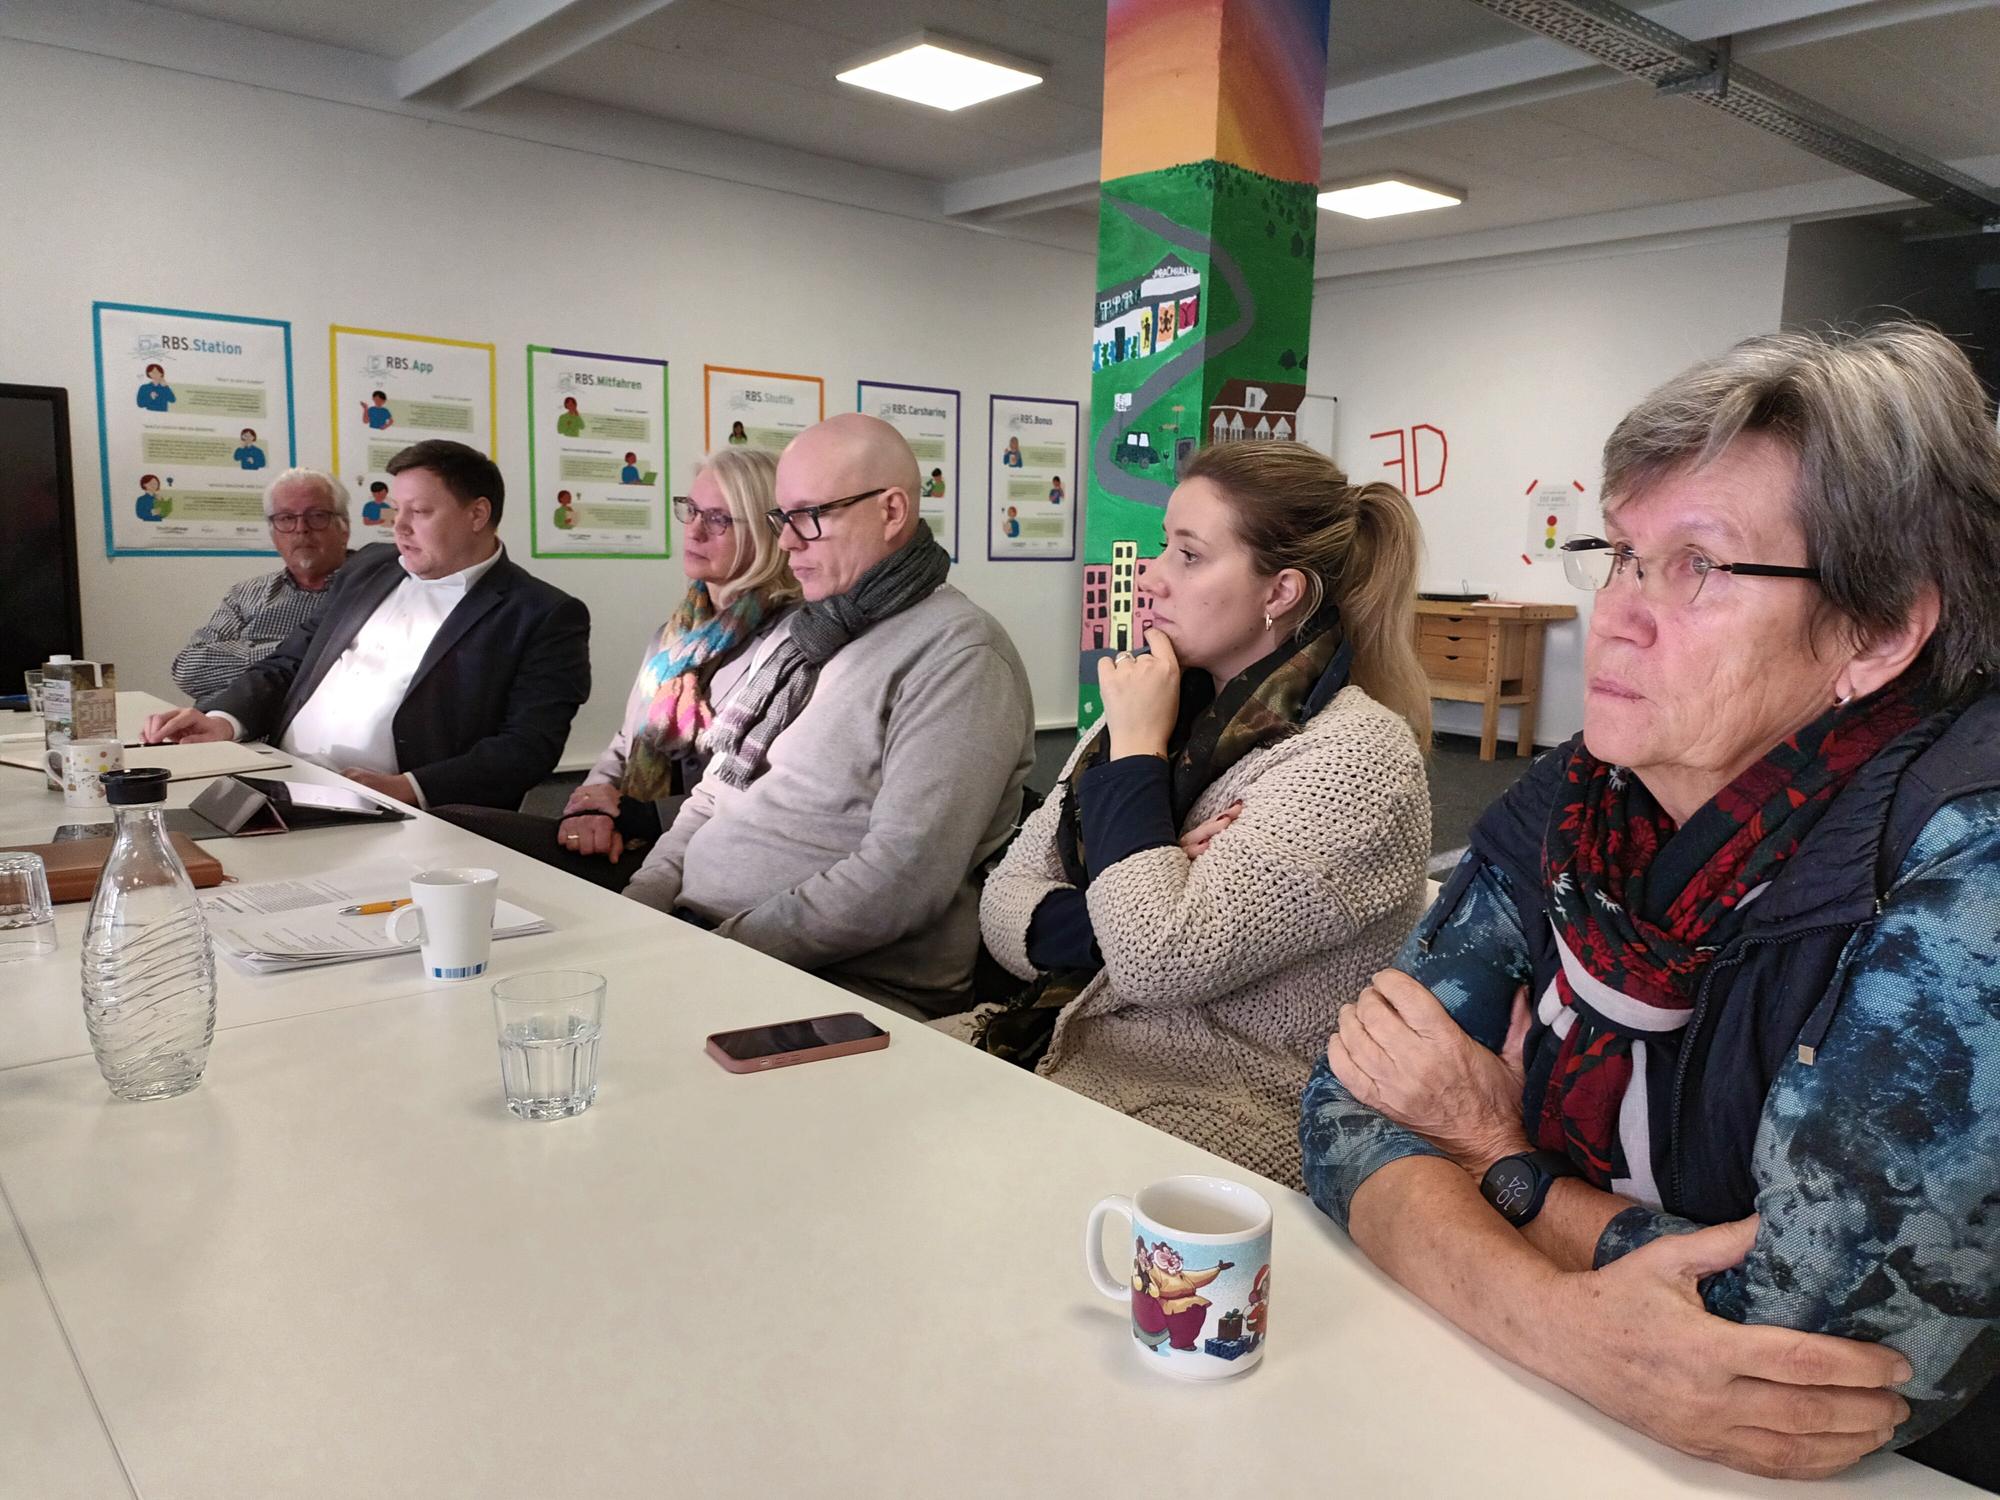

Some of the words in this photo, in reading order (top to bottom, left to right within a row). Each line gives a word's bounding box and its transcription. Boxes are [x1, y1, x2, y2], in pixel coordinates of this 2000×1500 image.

[161, 335, 242, 355] RBS.Station
[386, 356, 433, 374] RBS.App
[574, 372, 642, 390] RBS.Mitfahren
[892, 403, 946, 419] RBS.Carsharing
